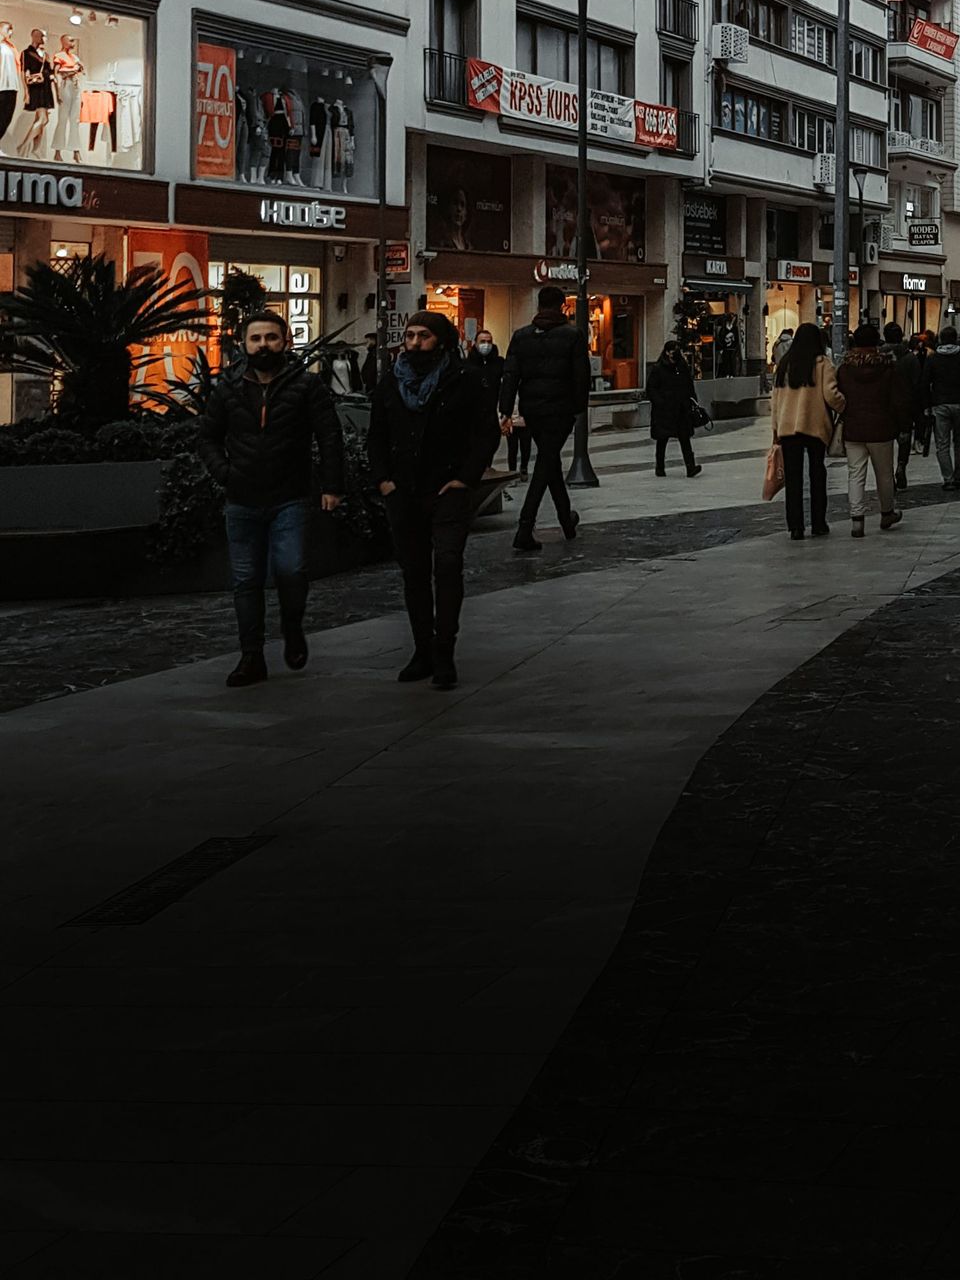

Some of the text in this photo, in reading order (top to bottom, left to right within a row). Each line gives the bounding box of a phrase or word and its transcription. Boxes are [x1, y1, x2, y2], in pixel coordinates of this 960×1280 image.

[510, 80, 543, 116] KPSS
[0, 171, 83, 207] rma
[910, 225, 938, 234] MODEL
[903, 274, 926, 291] flormar
